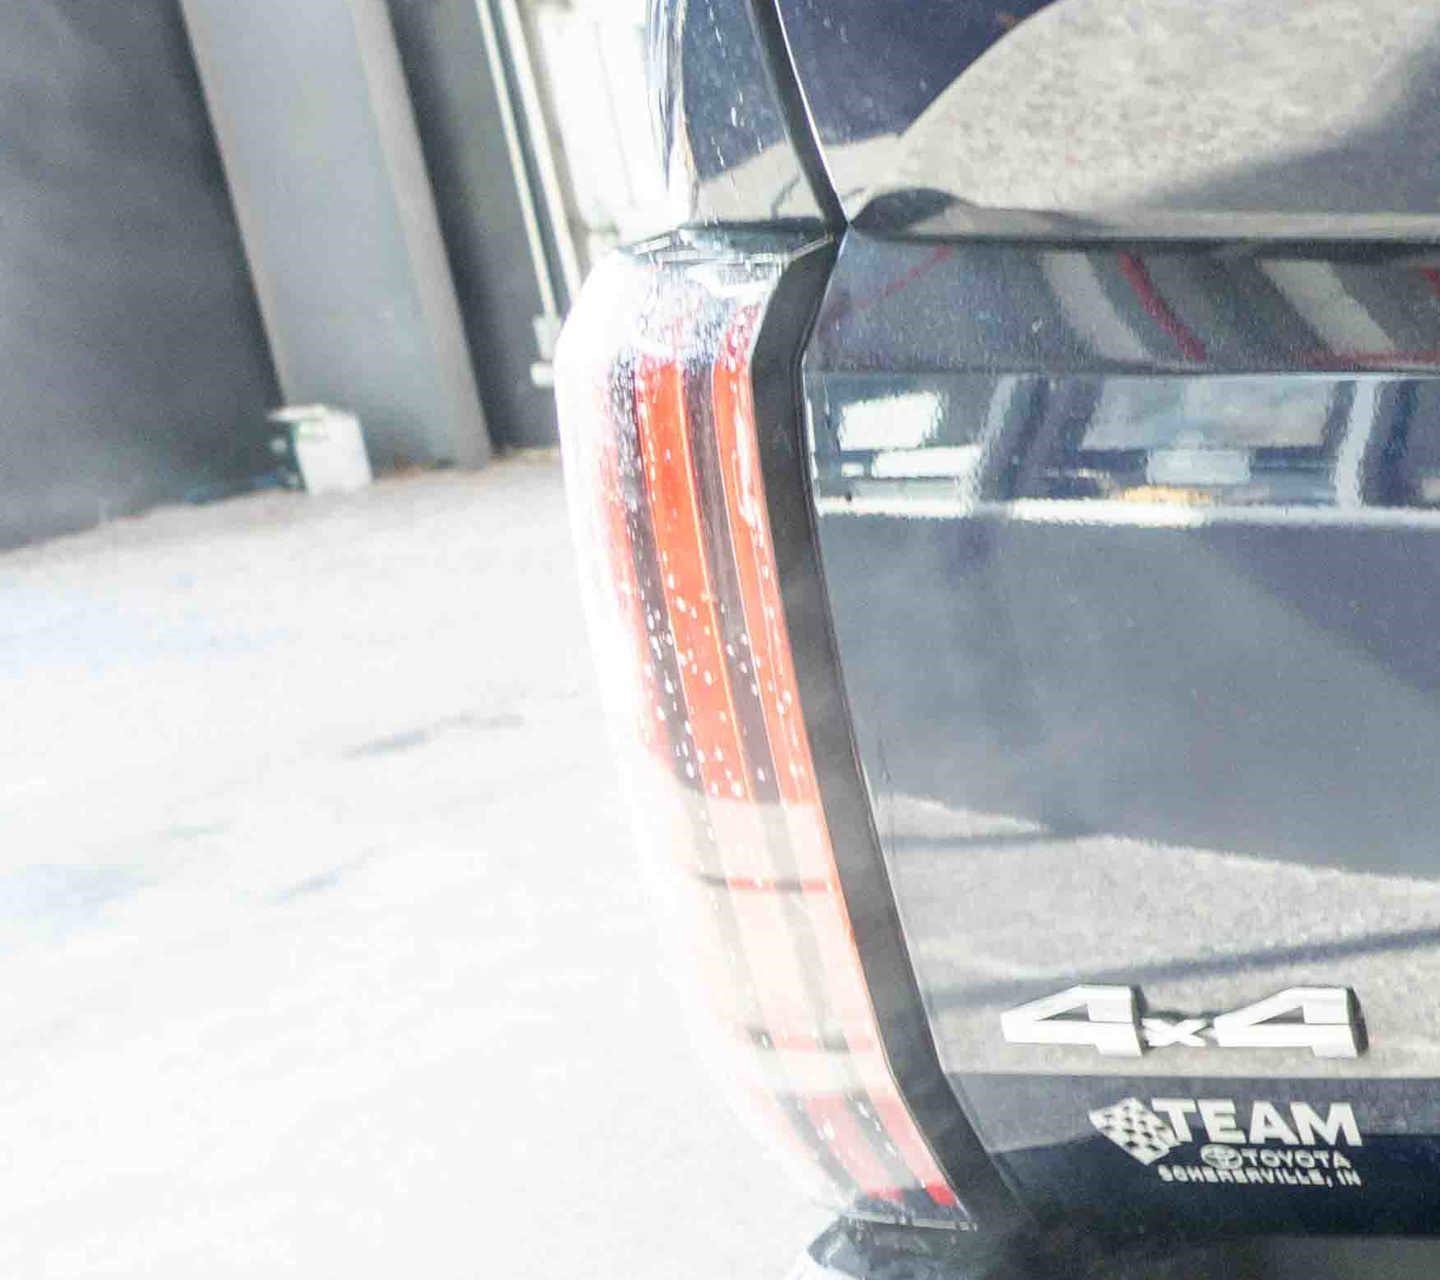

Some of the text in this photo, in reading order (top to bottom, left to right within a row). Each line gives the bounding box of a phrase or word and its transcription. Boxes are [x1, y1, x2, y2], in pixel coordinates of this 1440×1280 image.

[1000, 983, 1365, 1058] 4x4
[1151, 1097, 1363, 1147] TEAM
[1241, 1148, 1352, 1169] TOYOTA
